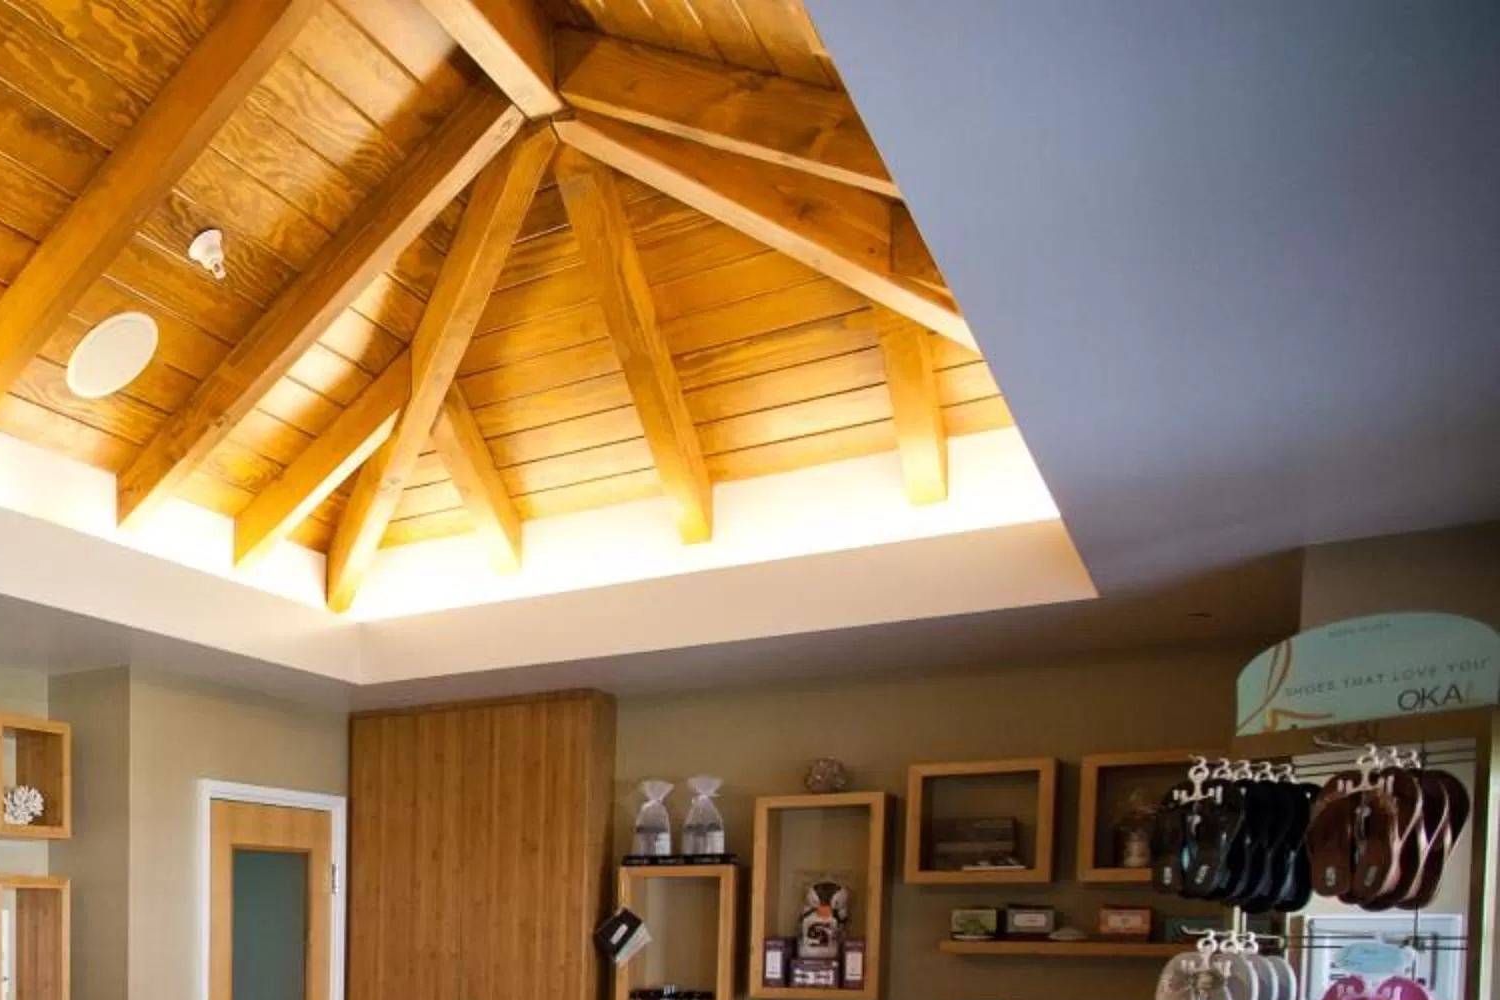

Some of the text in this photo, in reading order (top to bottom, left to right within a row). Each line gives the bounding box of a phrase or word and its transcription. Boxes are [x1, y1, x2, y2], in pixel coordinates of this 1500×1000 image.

[1285, 683, 1336, 697] SHOES
[1343, 673, 1385, 688] THAT
[1393, 665, 1437, 683] LOVE
